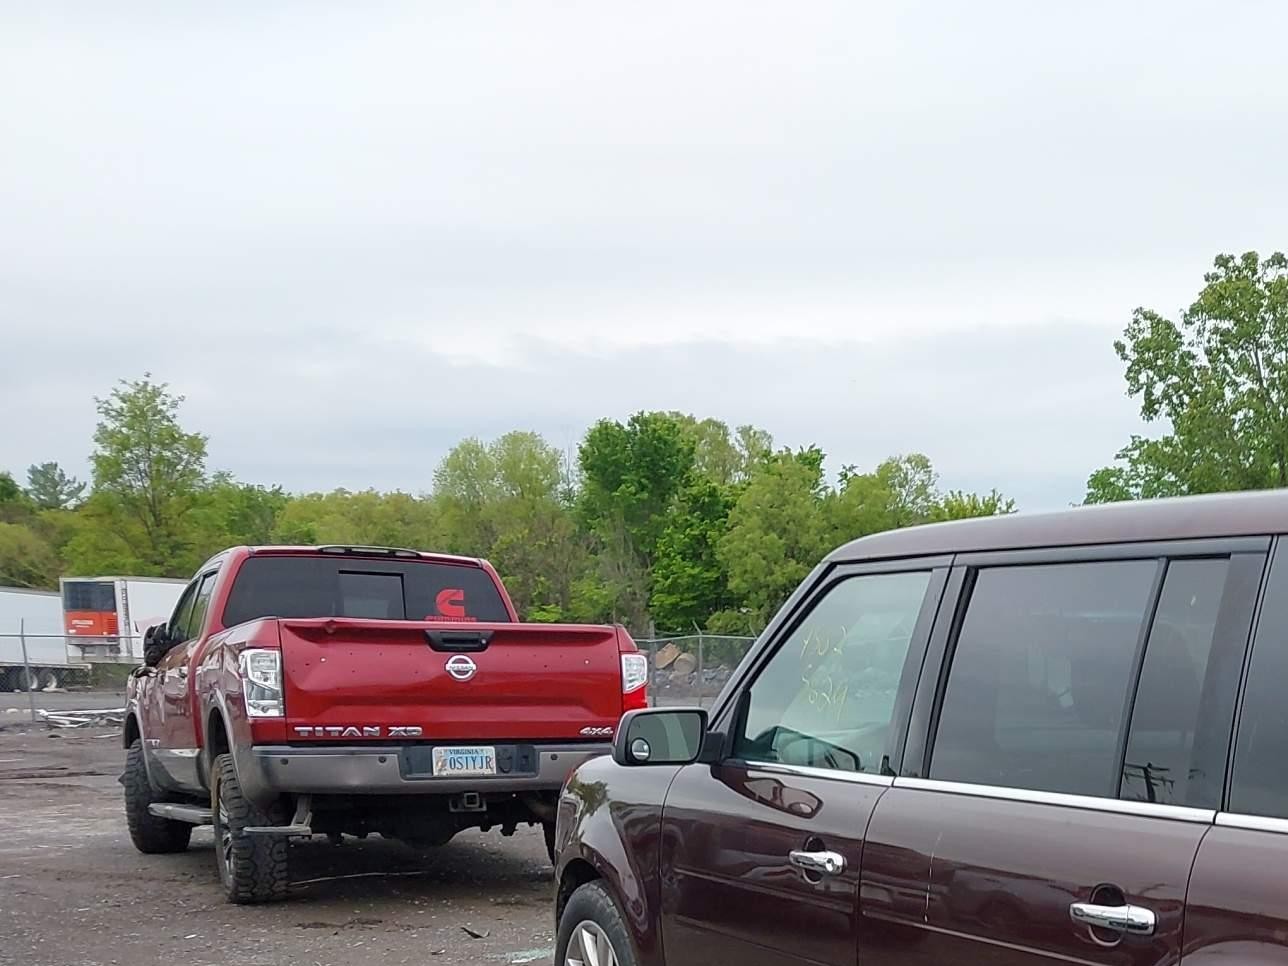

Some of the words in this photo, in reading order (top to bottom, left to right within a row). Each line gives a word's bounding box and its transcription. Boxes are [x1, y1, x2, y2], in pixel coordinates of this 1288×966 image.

[293, 725, 381, 738] TITAN
[387, 725, 424, 737] XD
[448, 748, 479, 756] VIRGINIA
